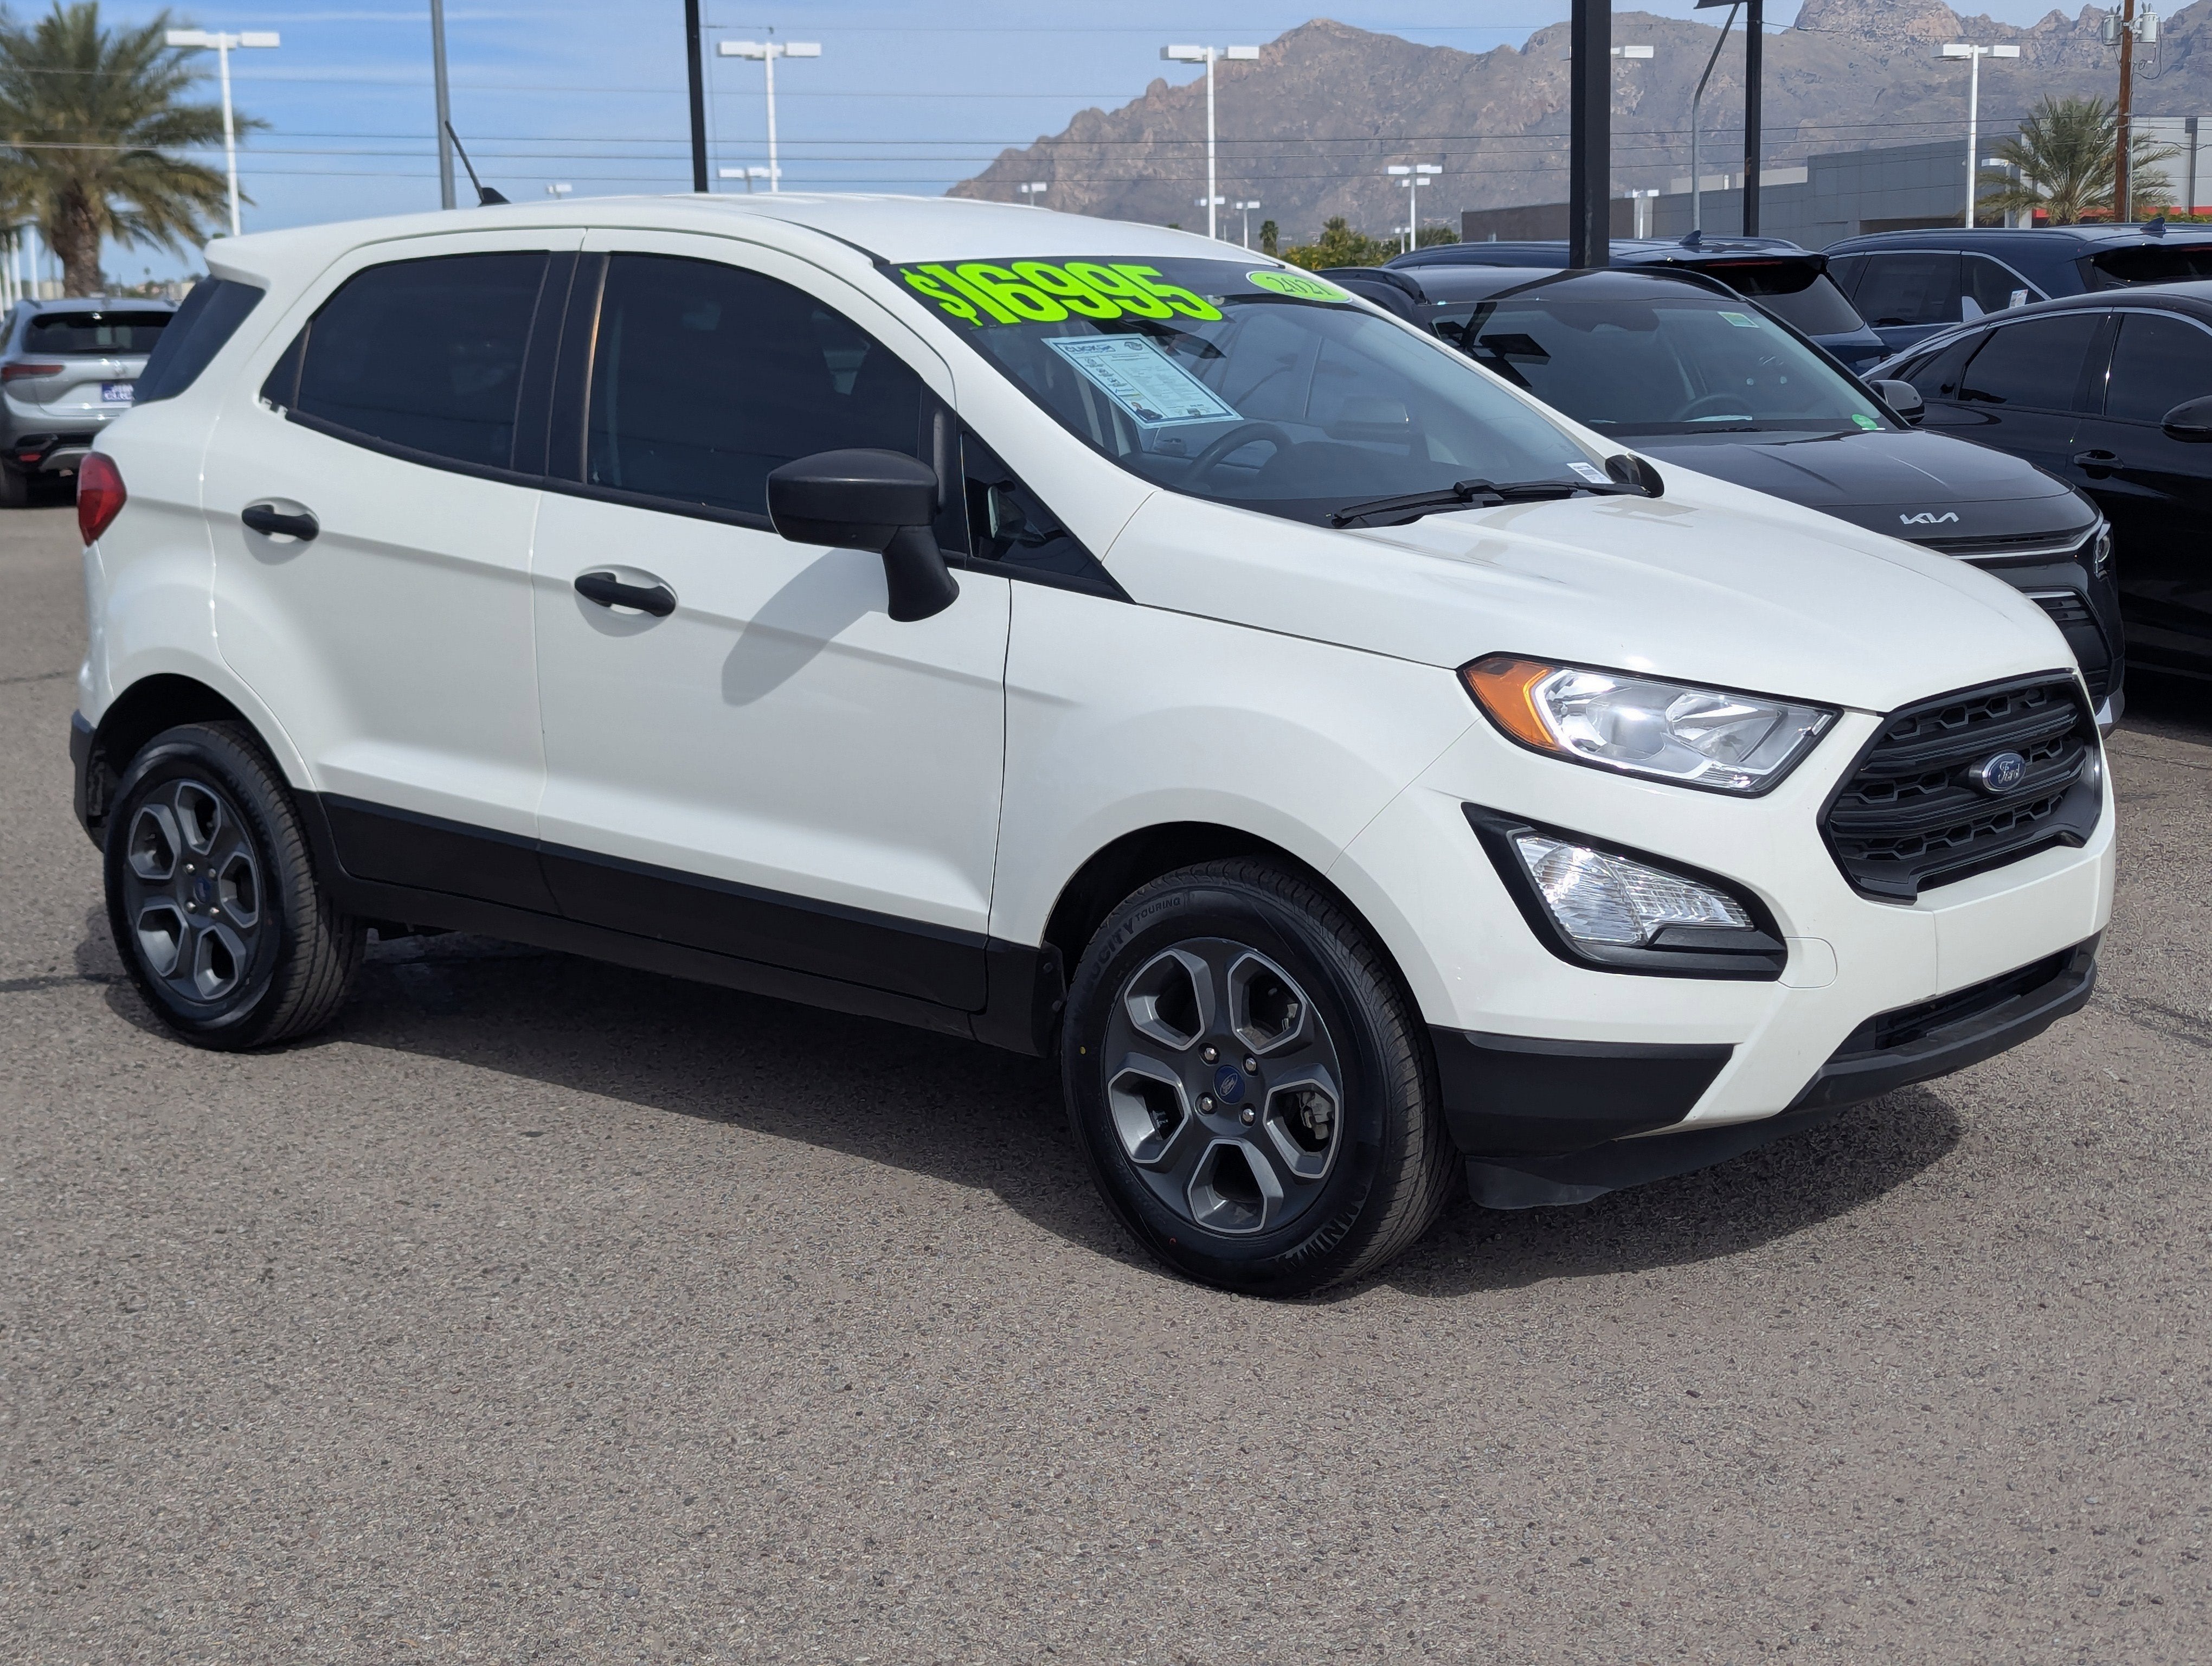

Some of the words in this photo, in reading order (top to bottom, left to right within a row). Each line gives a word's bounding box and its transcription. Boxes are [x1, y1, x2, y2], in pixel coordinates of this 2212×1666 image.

[899, 261, 1223, 326] $16995
[1265, 277, 1334, 297] 2021
[1899, 511, 1959, 525] KIA
[1998, 760, 2021, 784] Ford
[1134, 897, 1181, 921] TOURING
